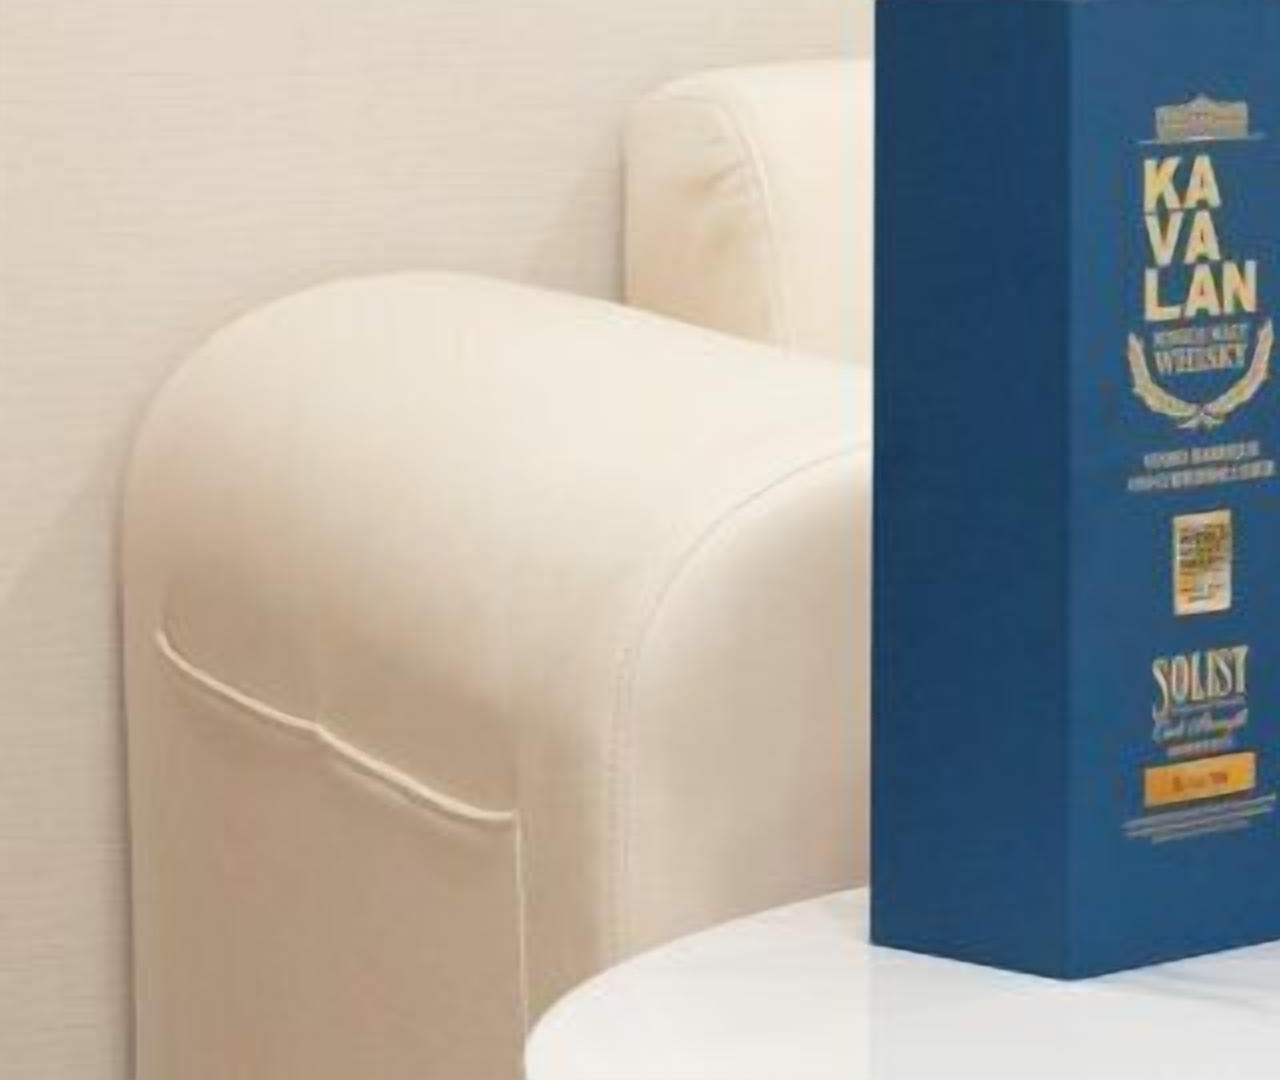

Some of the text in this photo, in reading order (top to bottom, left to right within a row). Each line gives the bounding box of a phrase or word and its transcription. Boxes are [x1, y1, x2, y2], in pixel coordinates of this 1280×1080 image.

[1144, 154, 1222, 210] KA
[1144, 209, 1221, 266] VA
[1144, 260, 1258, 321] LAN
[1152, 645, 1249, 721] SOLIST
